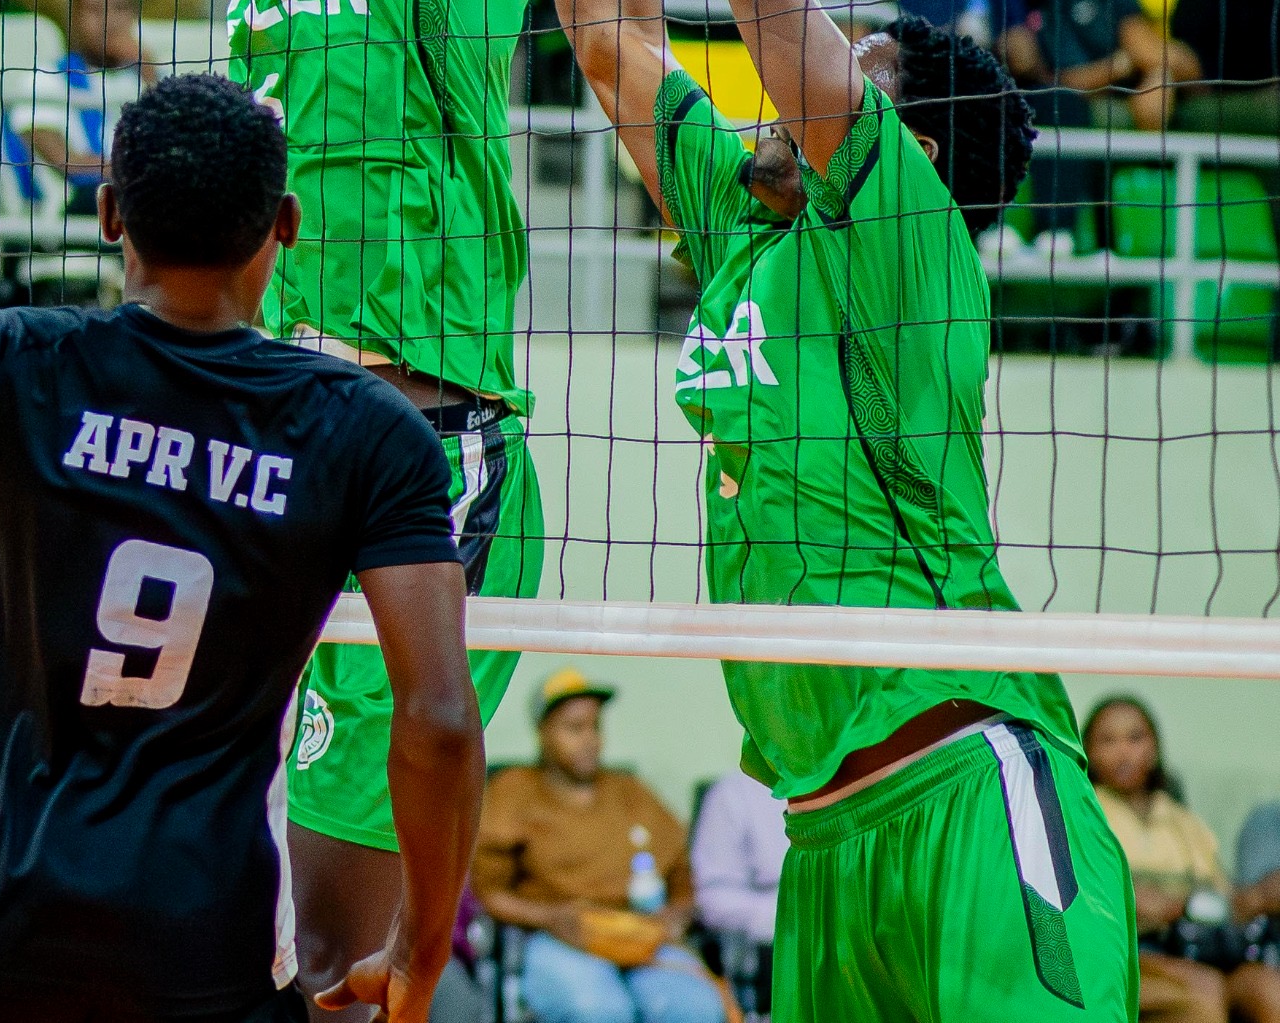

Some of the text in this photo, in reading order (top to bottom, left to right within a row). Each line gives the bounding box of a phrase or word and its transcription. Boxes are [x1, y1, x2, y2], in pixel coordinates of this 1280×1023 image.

[63, 410, 293, 515] APR V.C
[80, 538, 214, 710] 9
